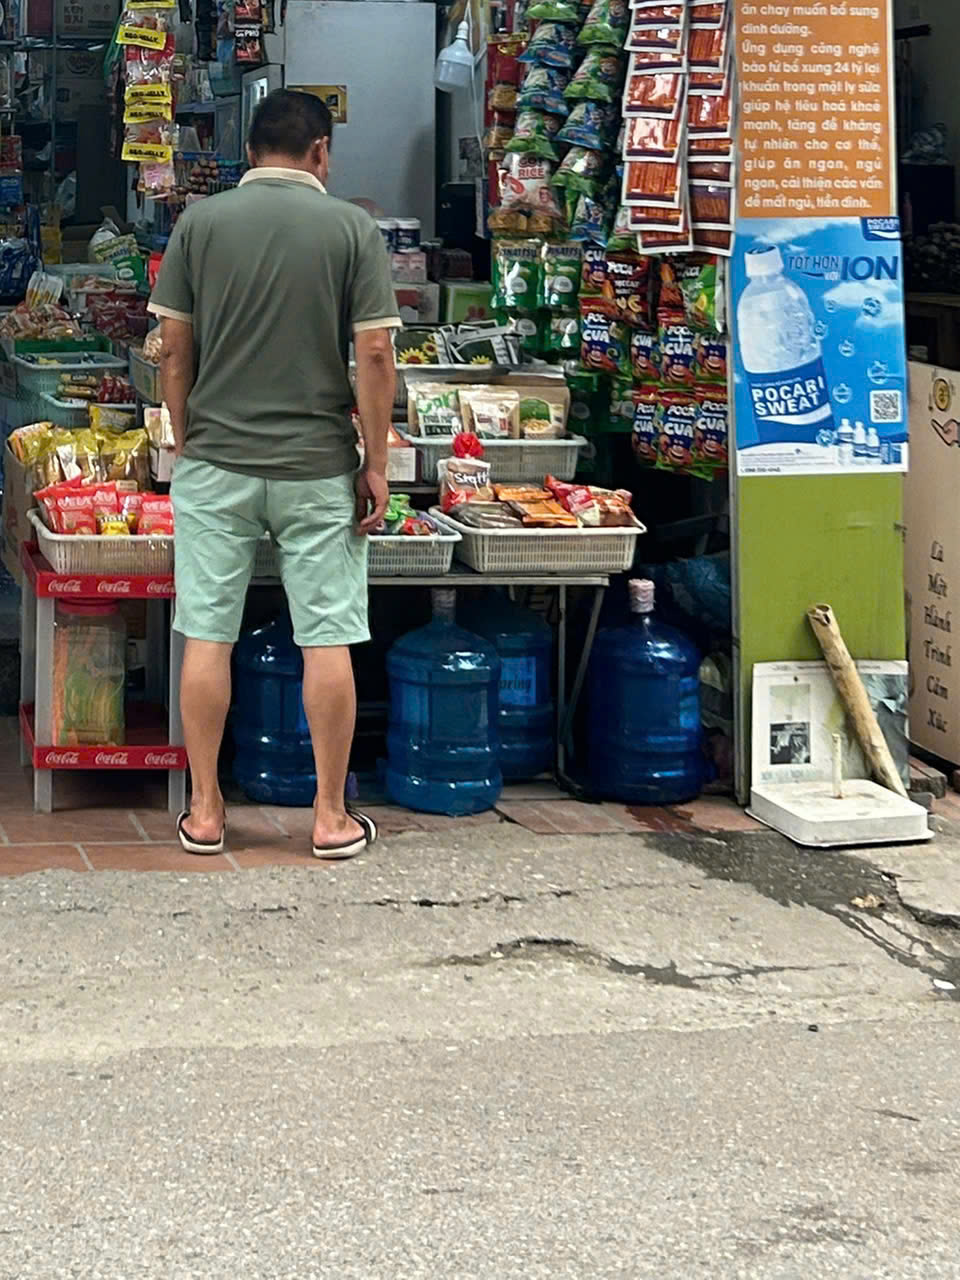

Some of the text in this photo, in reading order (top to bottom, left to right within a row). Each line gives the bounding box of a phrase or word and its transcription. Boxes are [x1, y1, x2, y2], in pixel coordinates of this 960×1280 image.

[834, 63, 849, 72] 24
[518, 167, 545, 178] RICE
[840, 256, 898, 280] ION
[582, 328, 610, 344] CUA
[634, 334, 652, 347] CUA
[665, 343, 693, 356] CUA
[751, 375, 825, 402] POCARI
[755, 393, 821, 416] SWEAT
[634, 420, 655, 433] CUA
[664, 422, 693, 438] CUA
[697, 417, 726, 432] CUA
